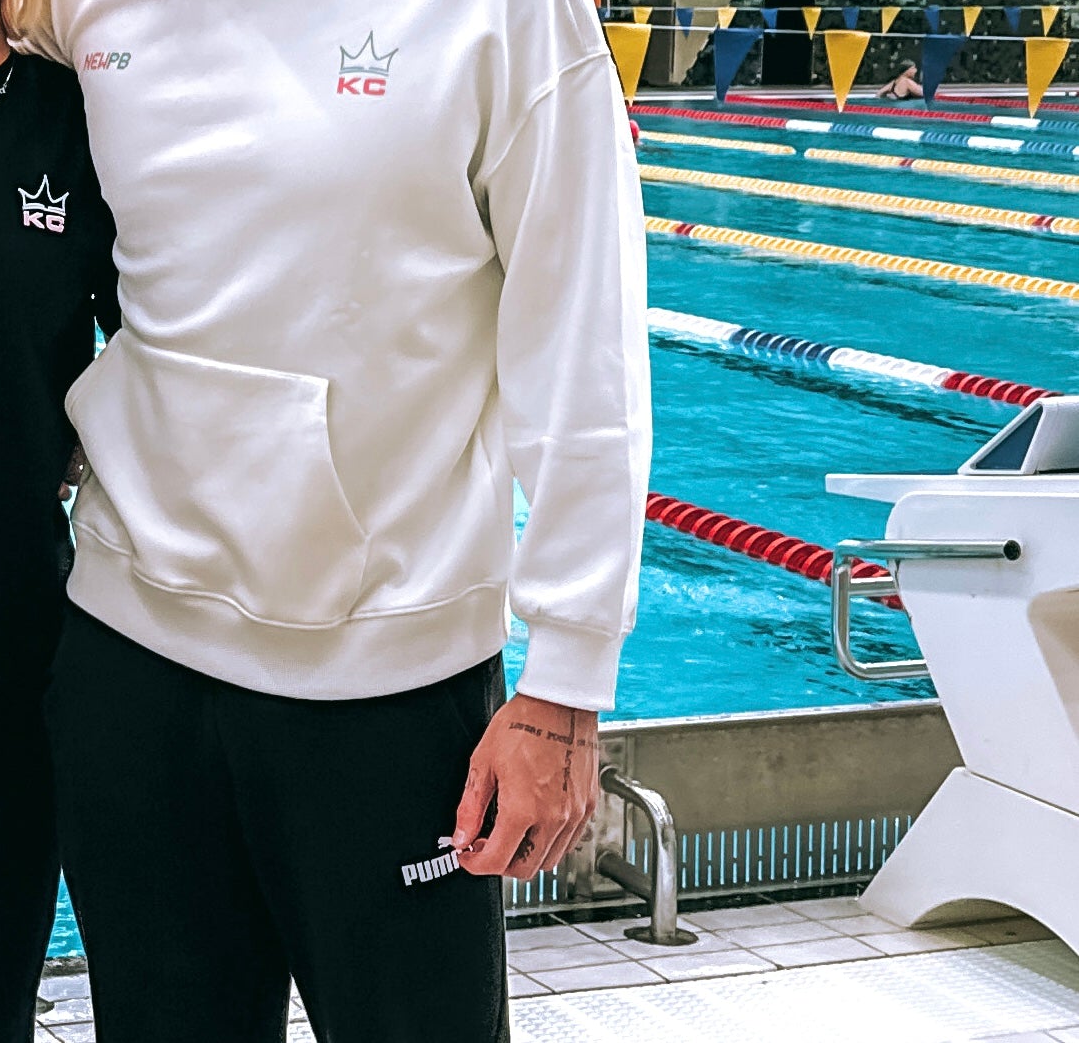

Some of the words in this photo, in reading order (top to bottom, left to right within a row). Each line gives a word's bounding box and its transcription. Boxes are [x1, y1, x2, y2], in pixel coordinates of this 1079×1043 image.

[83, 51, 131, 70] NEWPB
[337, 76, 387, 96] KC
[23, 210, 65, 233] KC
